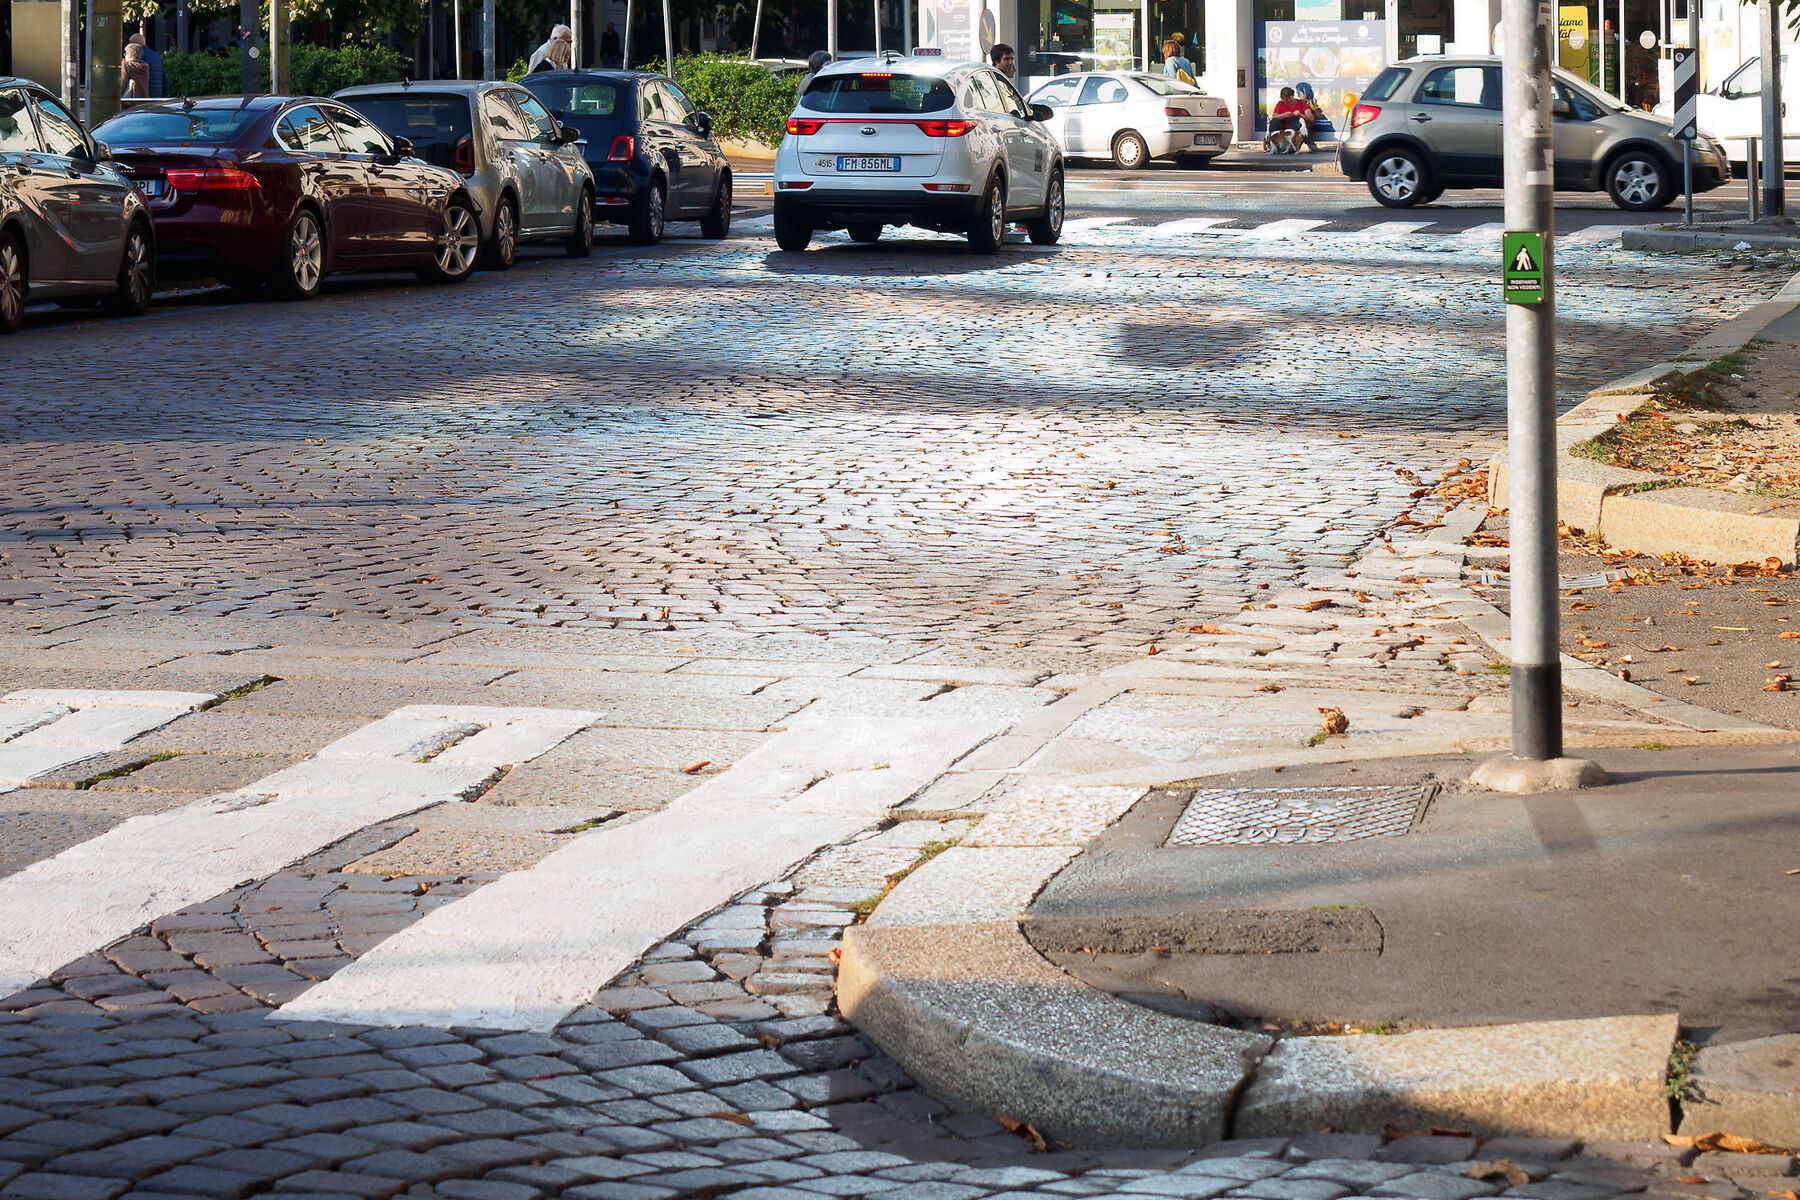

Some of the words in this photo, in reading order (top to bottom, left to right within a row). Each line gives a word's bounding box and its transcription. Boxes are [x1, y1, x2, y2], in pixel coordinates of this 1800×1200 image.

[1559, 18, 1584, 27] iamo
[817, 159, 832, 168] 4515
[844, 158, 858, 170] FM
[860, 158, 893, 170] 856ML
[136, 181, 153, 195] PL
[1248, 826, 1337, 839] SEM
